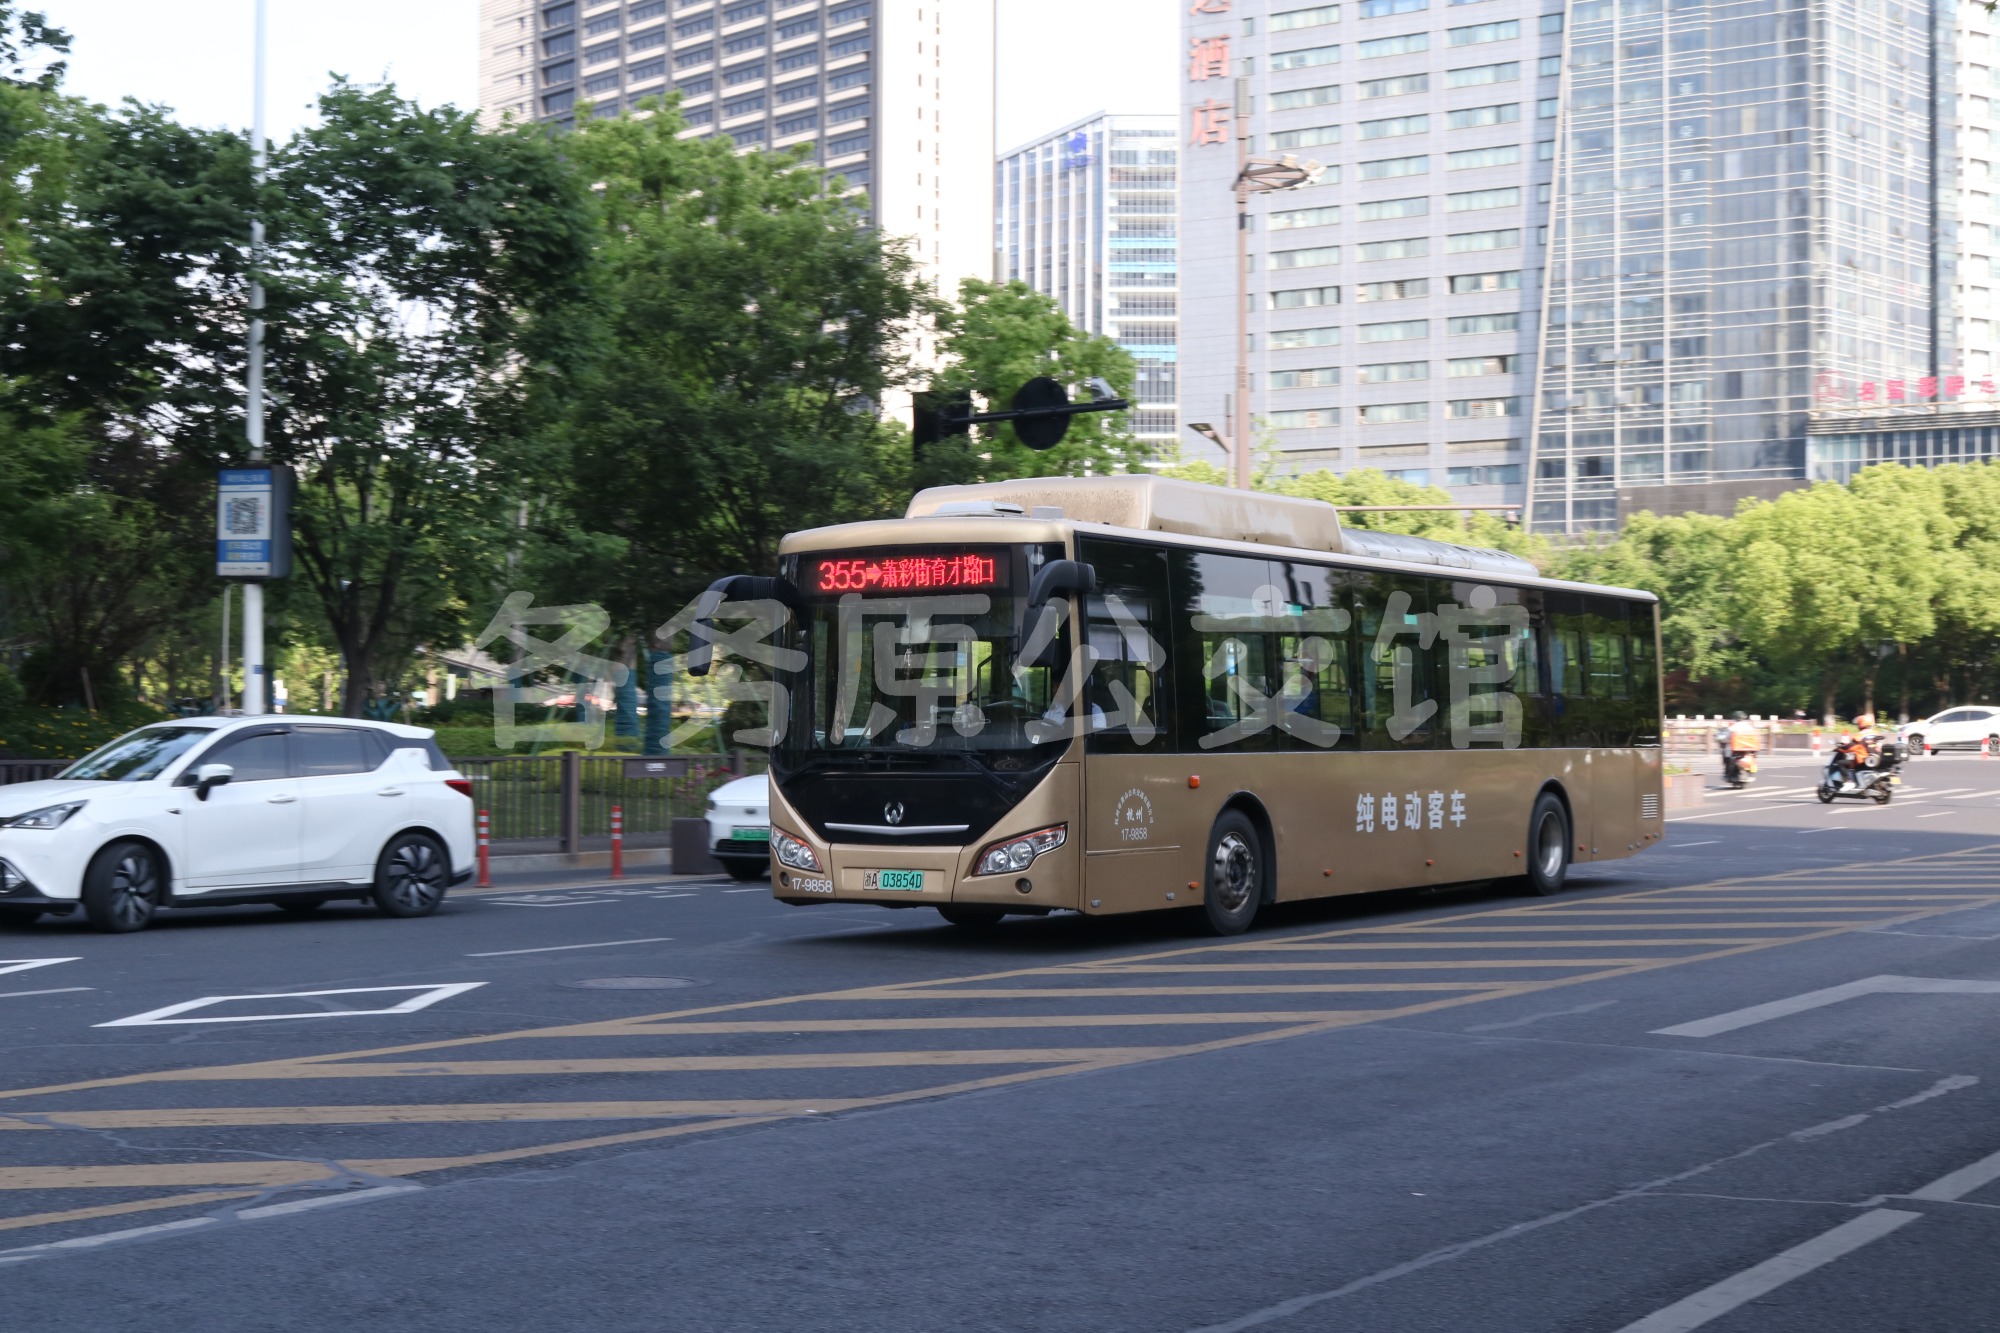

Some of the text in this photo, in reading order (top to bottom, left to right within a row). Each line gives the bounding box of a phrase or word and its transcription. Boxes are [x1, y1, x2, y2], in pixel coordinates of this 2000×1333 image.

[819, 560, 867, 590] 355
[1355, 789, 1467, 833] 纯电动客车
[1121, 827, 1147, 841] 17-9858
[791, 876, 833, 894] 17-9858
